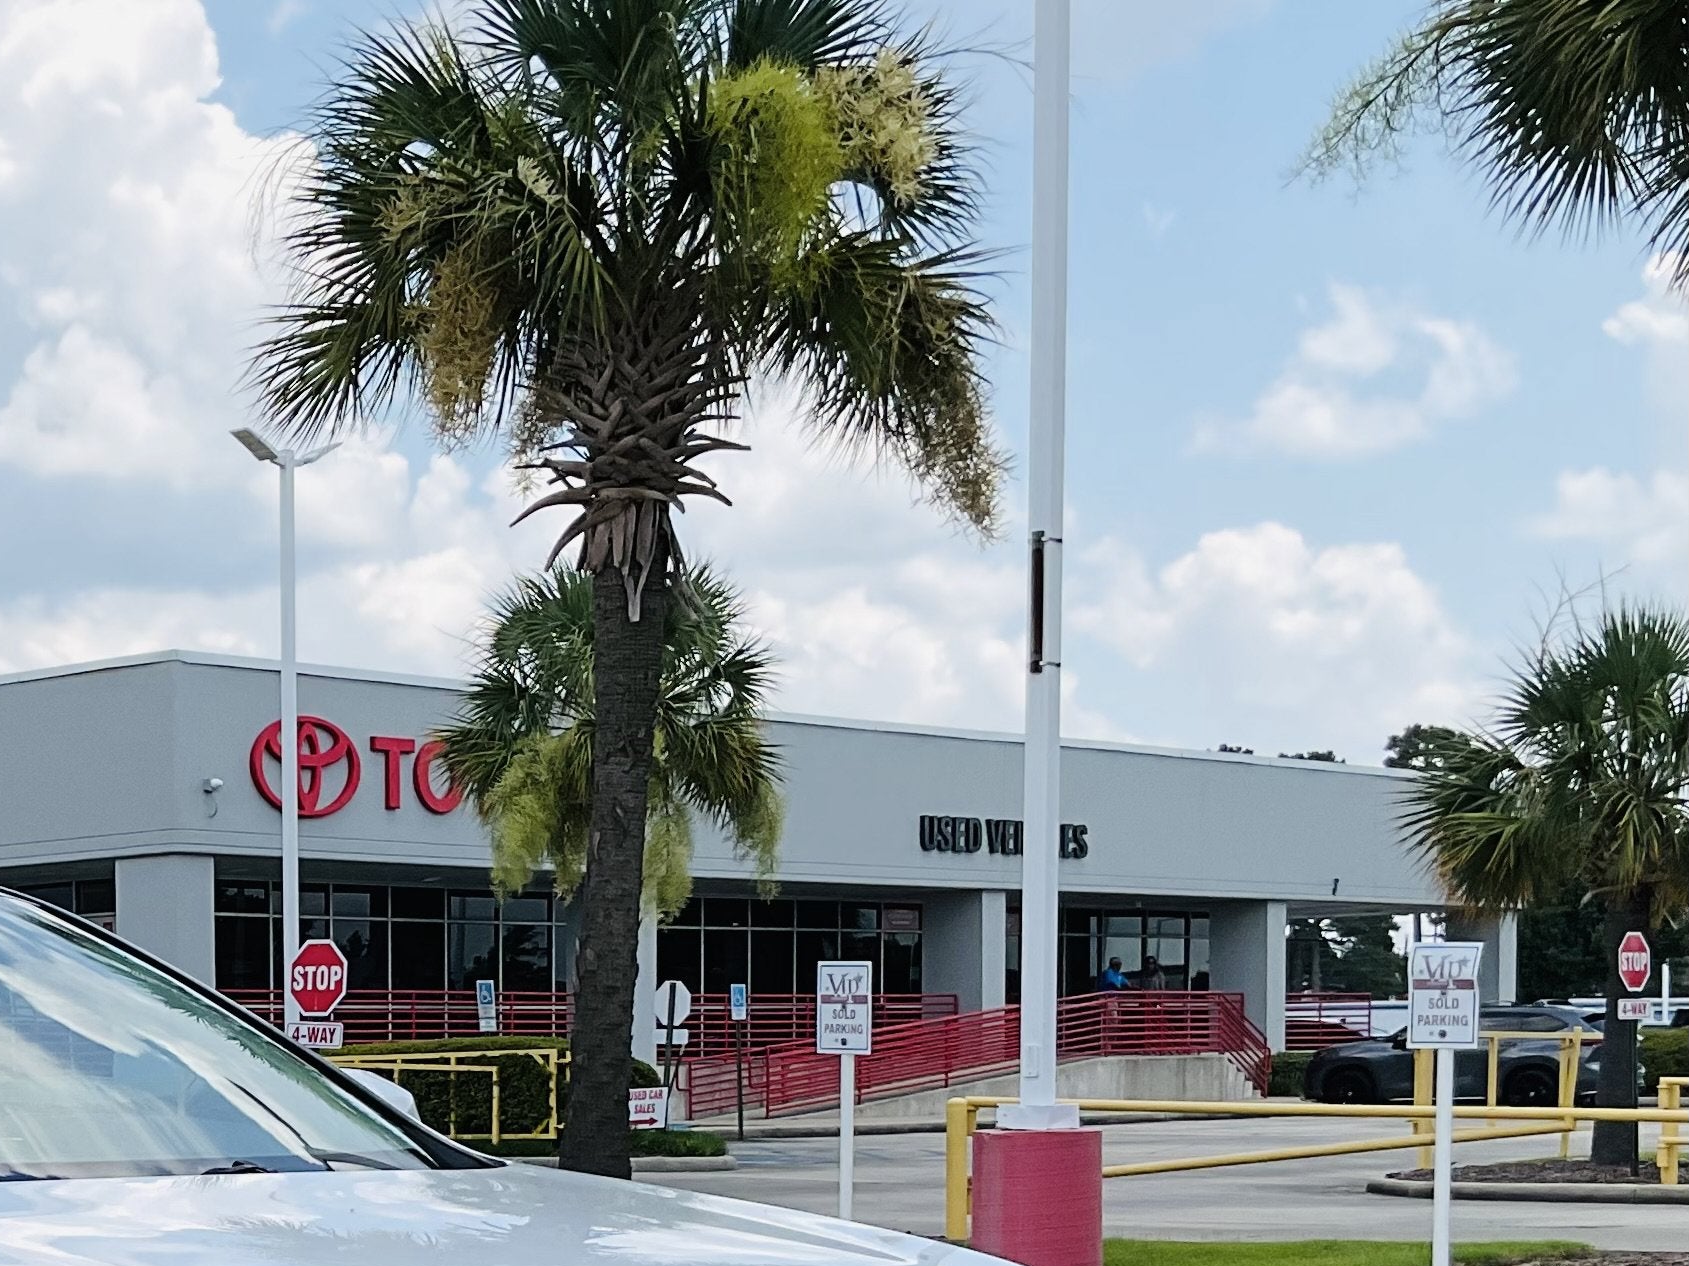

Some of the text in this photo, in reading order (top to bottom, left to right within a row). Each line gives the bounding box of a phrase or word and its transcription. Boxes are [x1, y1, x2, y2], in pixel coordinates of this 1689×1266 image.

[919, 815, 983, 854] USED
[1621, 951, 1647, 972] STOP
[292, 964, 343, 992] STOP
[1427, 998, 1460, 1010] SOLD
[1622, 1002, 1648, 1016] 4-WAY
[832, 1008, 856, 1020] SOLD
[1417, 1014, 1469, 1026] PARKING
[292, 1026, 337, 1044] 4-WAY
[824, 1023, 864, 1035] PARKING
[649, 1089, 664, 1100] CAR
[634, 1103, 656, 1115] SALES
